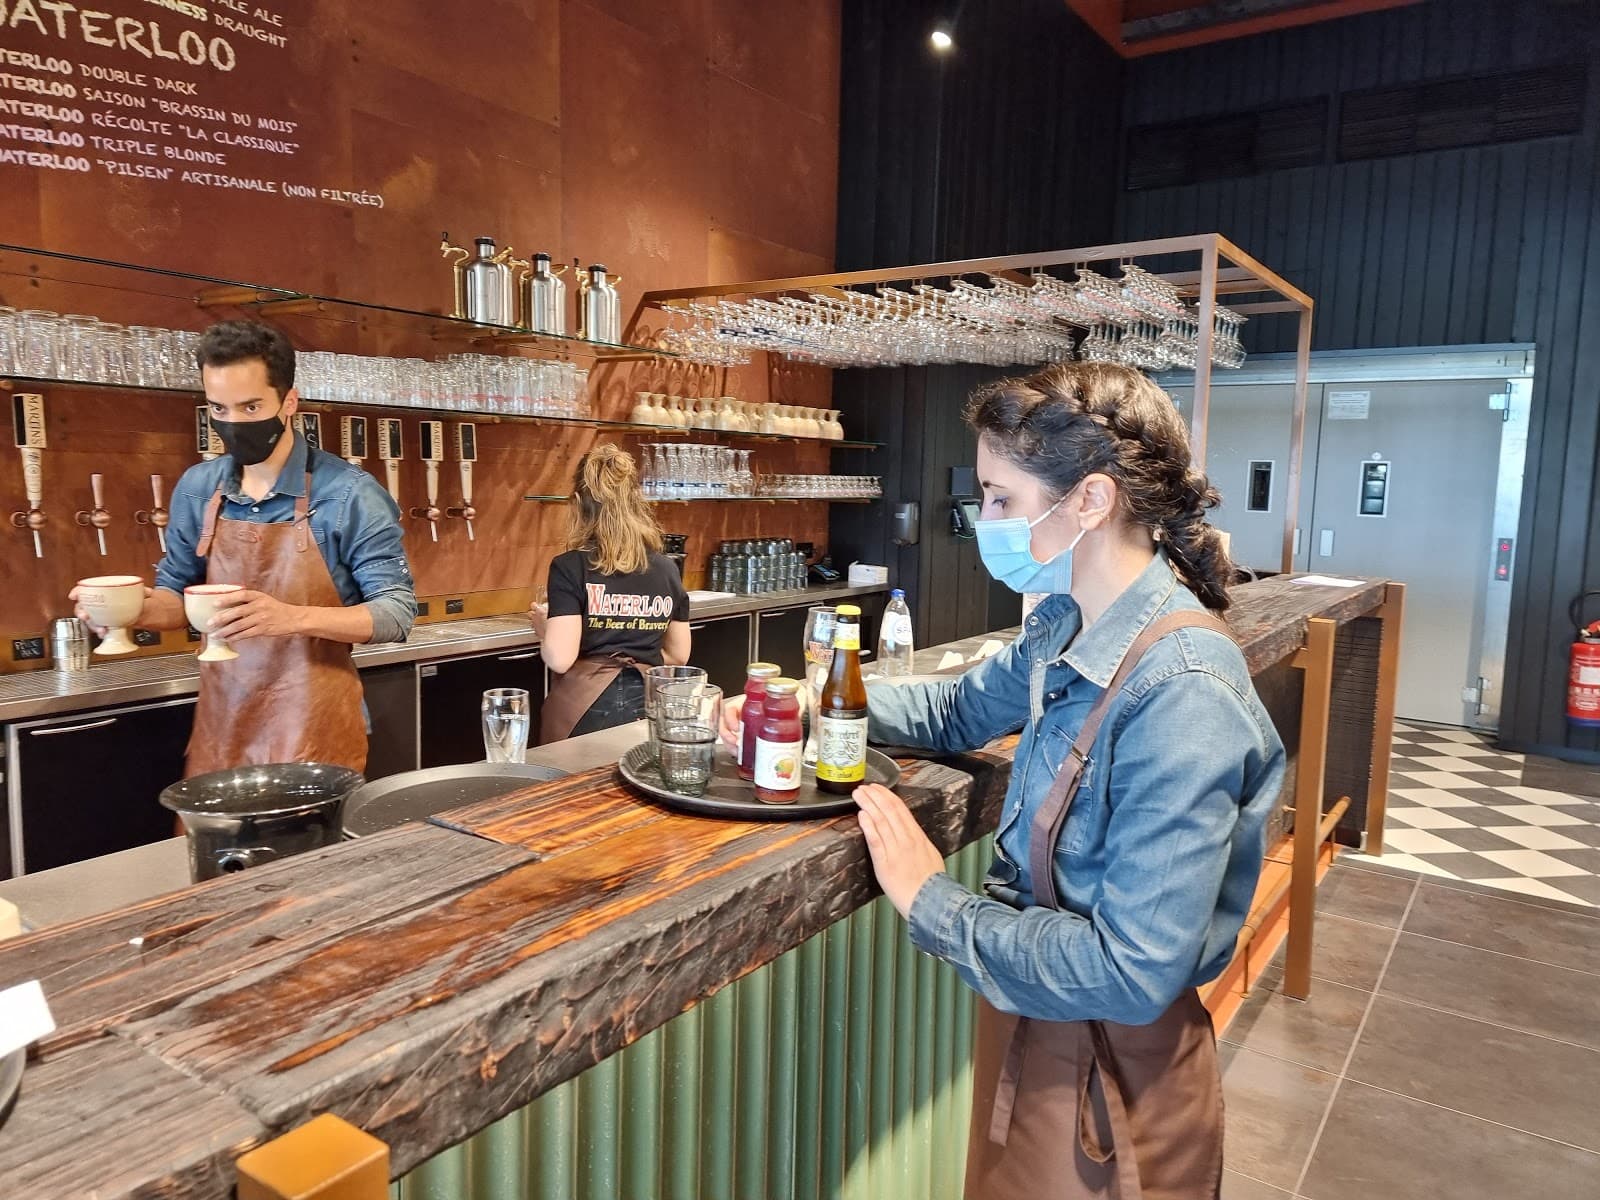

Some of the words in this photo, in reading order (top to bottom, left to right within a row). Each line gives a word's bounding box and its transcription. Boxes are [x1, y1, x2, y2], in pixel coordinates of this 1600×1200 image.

[211, 0, 248, 14] ALE
[254, 8, 283, 27] ALE
[214, 13, 287, 48] DRAUGHT
[78, 63, 149, 87] DOUBLE
[153, 77, 199, 95] DARK
[0, 73, 77, 98] TERLOO
[82, 87, 146, 108] SAISON
[151, 97, 227, 122] "BRASSIN
[232, 112, 250, 127] DU
[257, 116, 298, 134] MOIS"
[91, 110, 173, 135] RÉCOLTE
[178, 124, 208, 142] "LA
[213, 131, 300, 154] CLASSIQUE"
[89, 135, 158, 156] TRIPLE
[164, 146, 226, 165] BLONDE
[97, 159, 173, 180] "PILSEN"
[181, 170, 277, 193] ARTISANALE
[282, 182, 316, 198] (NON
[321, 189, 384, 208] FILTRÉE)
[28, 395, 41, 445] MARTINS
[586, 583, 673, 617] WATERLOO
[588, 617, 604, 628] The
[605, 618, 625, 629] Beer
[626, 618, 638, 630] of
